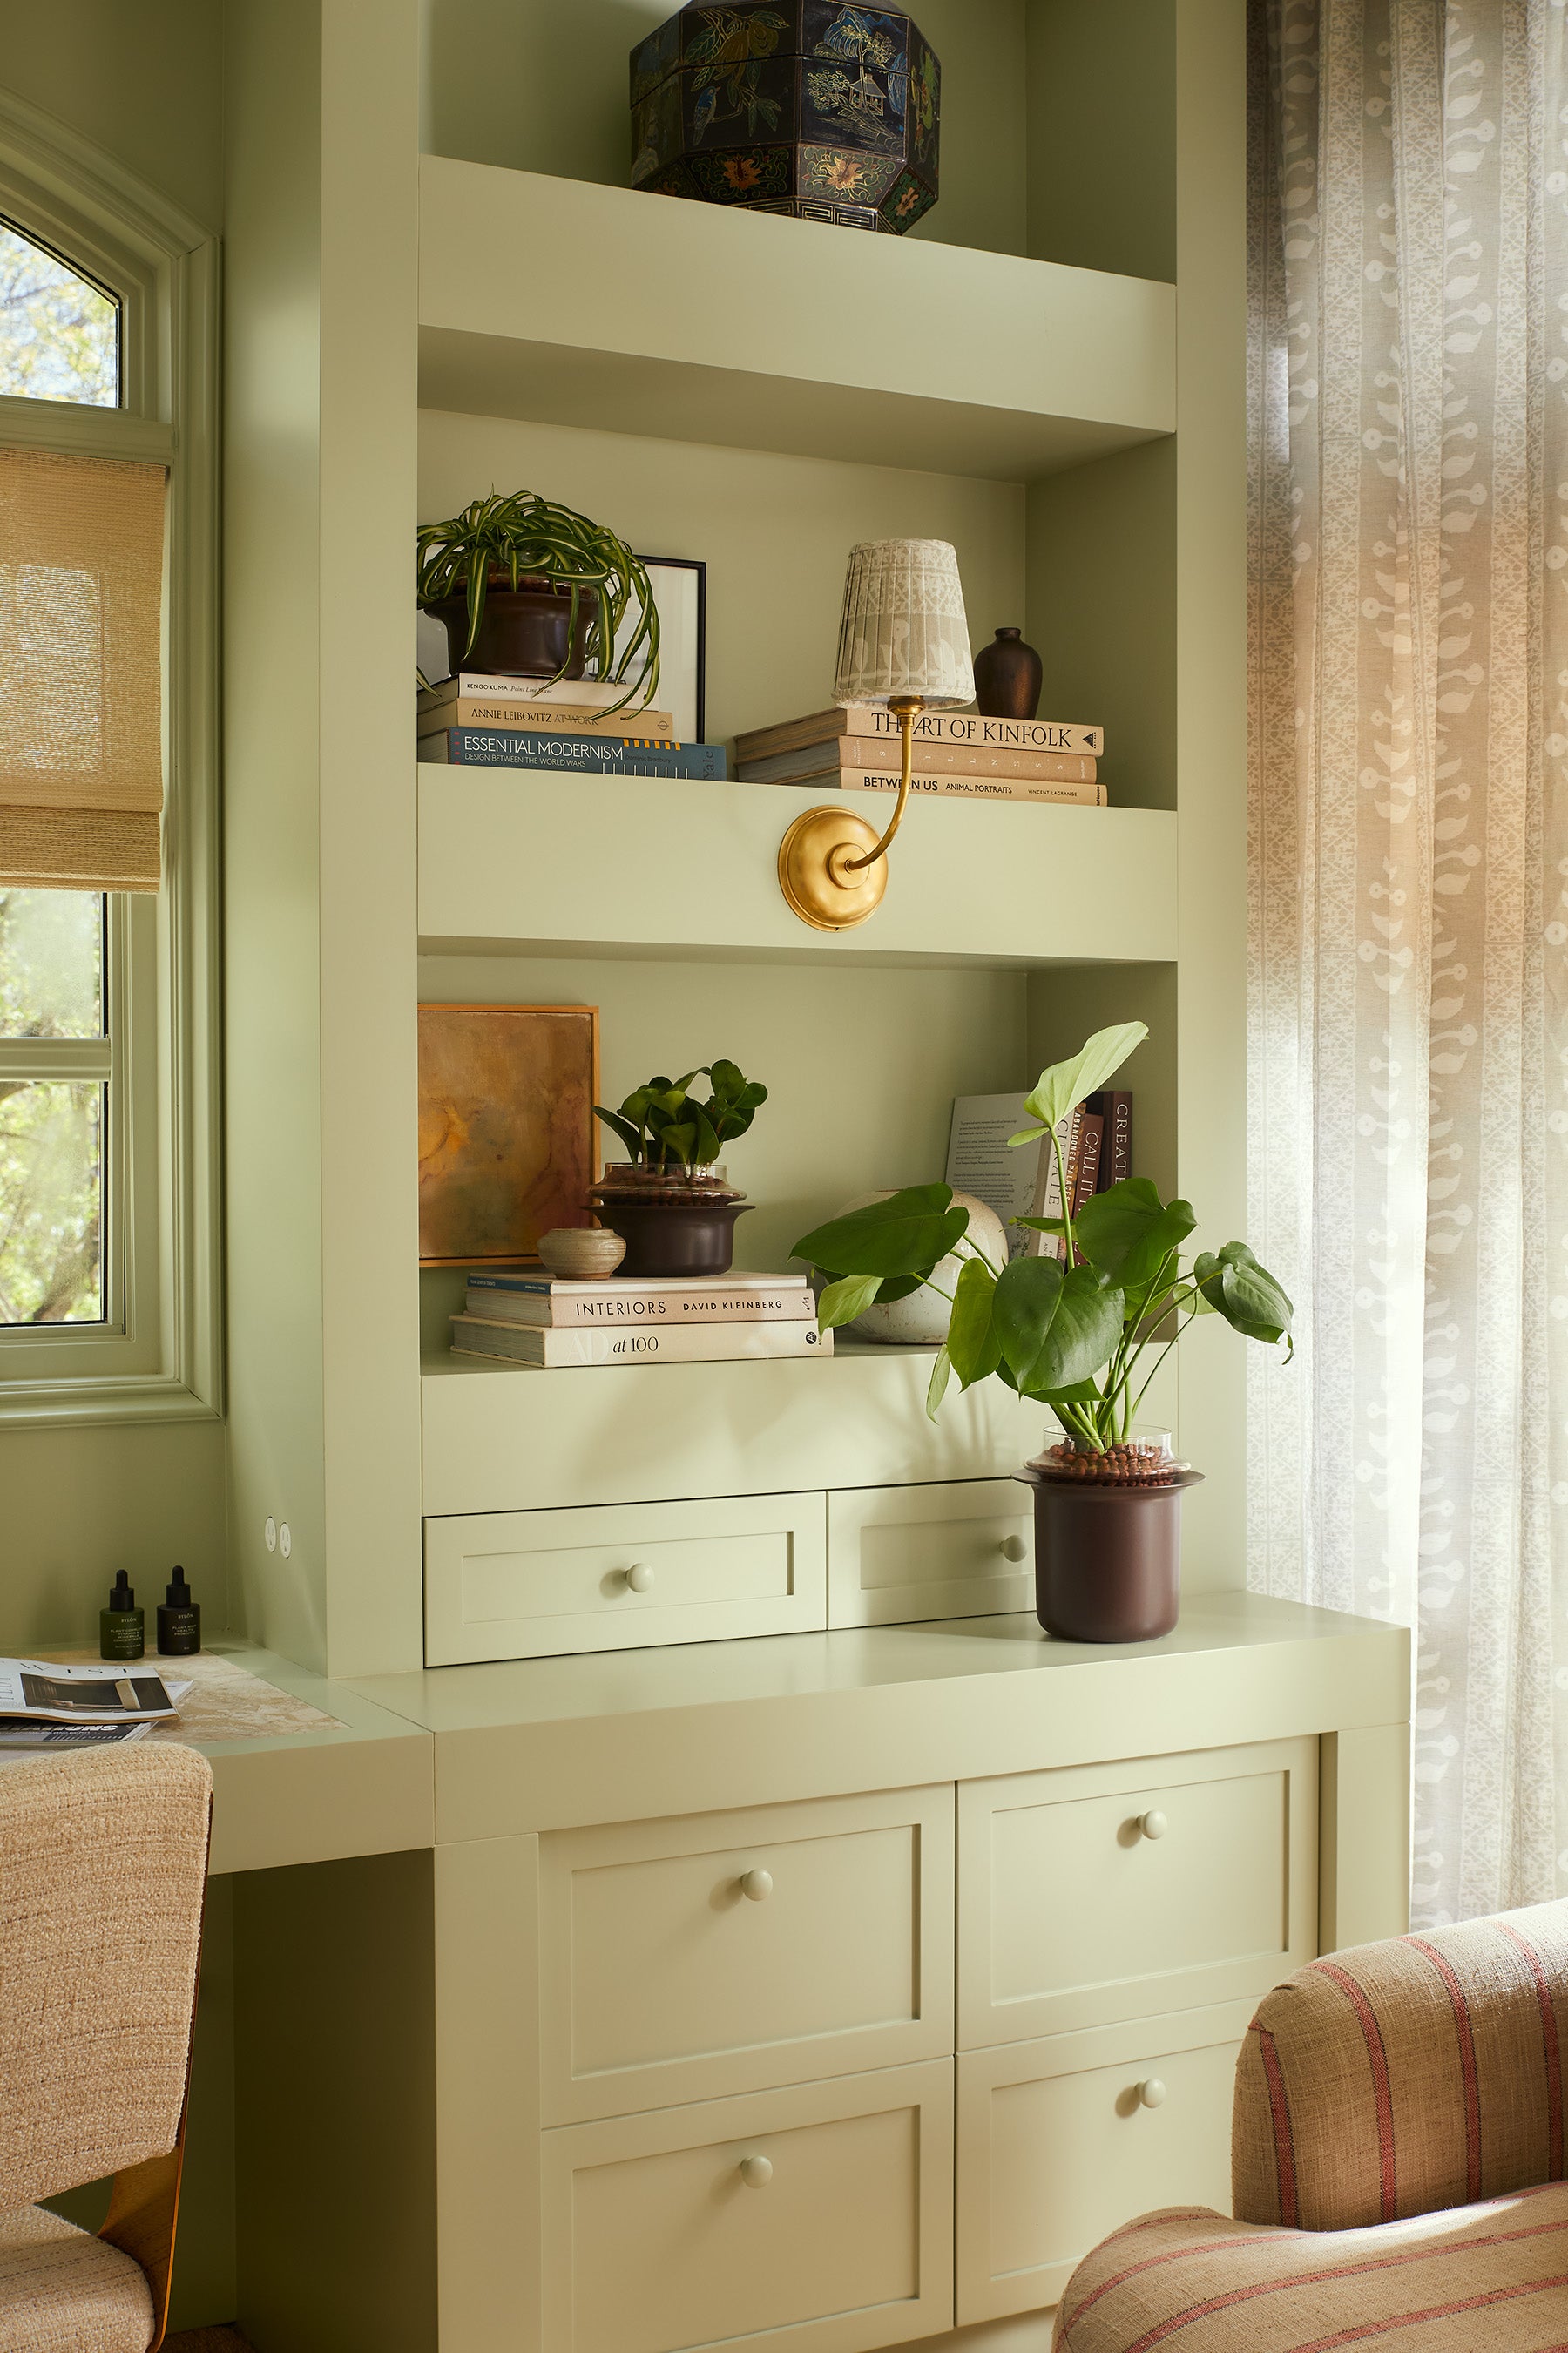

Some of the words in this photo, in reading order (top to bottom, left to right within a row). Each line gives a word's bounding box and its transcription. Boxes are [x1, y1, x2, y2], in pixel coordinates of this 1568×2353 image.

[471, 708, 502, 719] ANNIE
[504, 711, 552, 723] LEIBOVITZ
[566, 715, 598, 726] WORK
[871, 713, 903, 734] TH
[913, 716, 946, 737] ART
[950, 720, 977, 739] OF
[983, 722, 1072, 748] KINFOLK
[464, 736, 536, 755] ESSENTIAL
[538, 740, 623, 761] MODERNISM
[492, 754, 524, 763] BETWEEN
[539, 757, 565, 767] WORLD
[702, 750, 715, 781] Yale
[863, 776, 920, 790] BETWN
[923, 781, 938, 791] US
[945, 783, 973, 792] ANIMAL
[974, 784, 1012, 794] PORTRAITS
[1068, 1112, 1081, 1161] ABANDONED
[1115, 1103, 1129, 1185] CREATE
[1082, 1132, 1099, 1175] CALL
[1080, 1180, 1094, 1197] IT
[576, 1301, 666, 1315] INTERIORS
[683, 1302, 717, 1311] DAVID
[722, 1301, 782, 1310] KLEINBERG
[612, 1338, 626, 1353] at
[631, 1336, 659, 1352] 100
